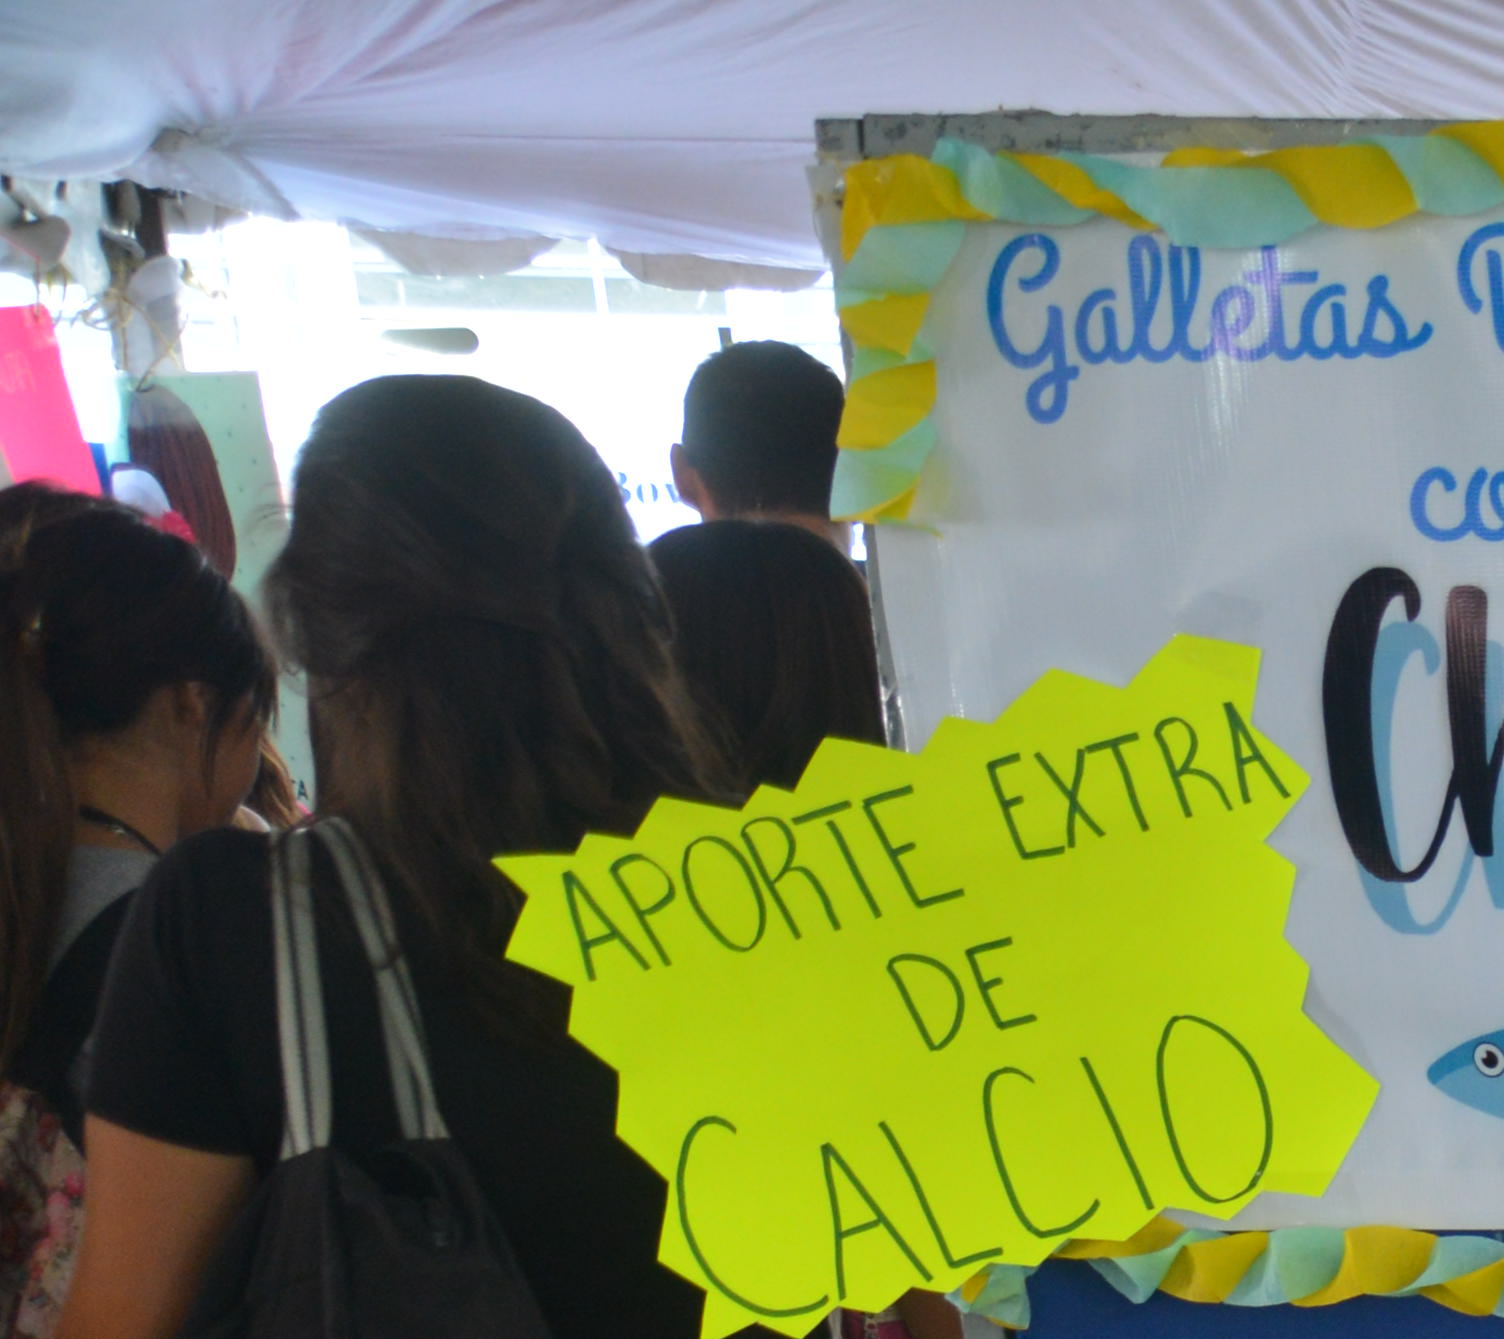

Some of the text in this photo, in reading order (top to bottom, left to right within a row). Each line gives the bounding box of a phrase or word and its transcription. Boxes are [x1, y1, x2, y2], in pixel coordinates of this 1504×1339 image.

[987, 226, 1434, 424] Galletas
[562, 701, 1291, 981] APORTE EXTRA
[887, 937, 1037, 1051] DE
[676, 1014, 1274, 1317] CALCIO
